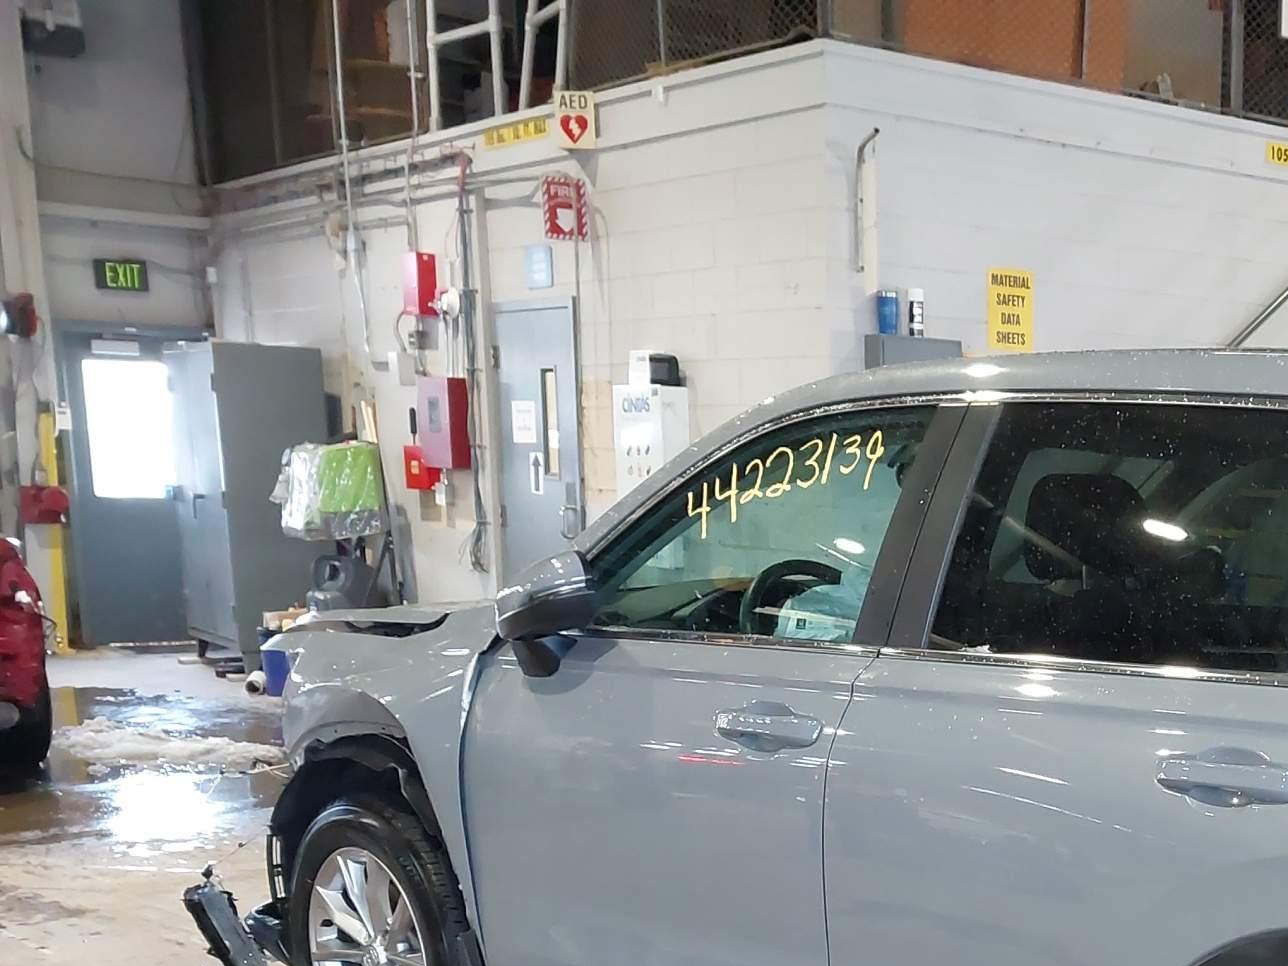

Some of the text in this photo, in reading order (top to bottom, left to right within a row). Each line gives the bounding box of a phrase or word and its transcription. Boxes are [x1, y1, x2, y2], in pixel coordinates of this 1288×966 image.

[559, 94, 588, 110] AED
[1271, 146, 1288, 162] 105
[550, 184, 575, 198] FIR
[105, 262, 141, 289] EXIT
[991, 272, 1031, 290] MATERIAL
[996, 292, 1026, 308] SAFETY
[1001, 312, 1021, 327] DATA
[996, 331, 1026, 346] SHEETS
[687, 430, 885, 540] 44223139
